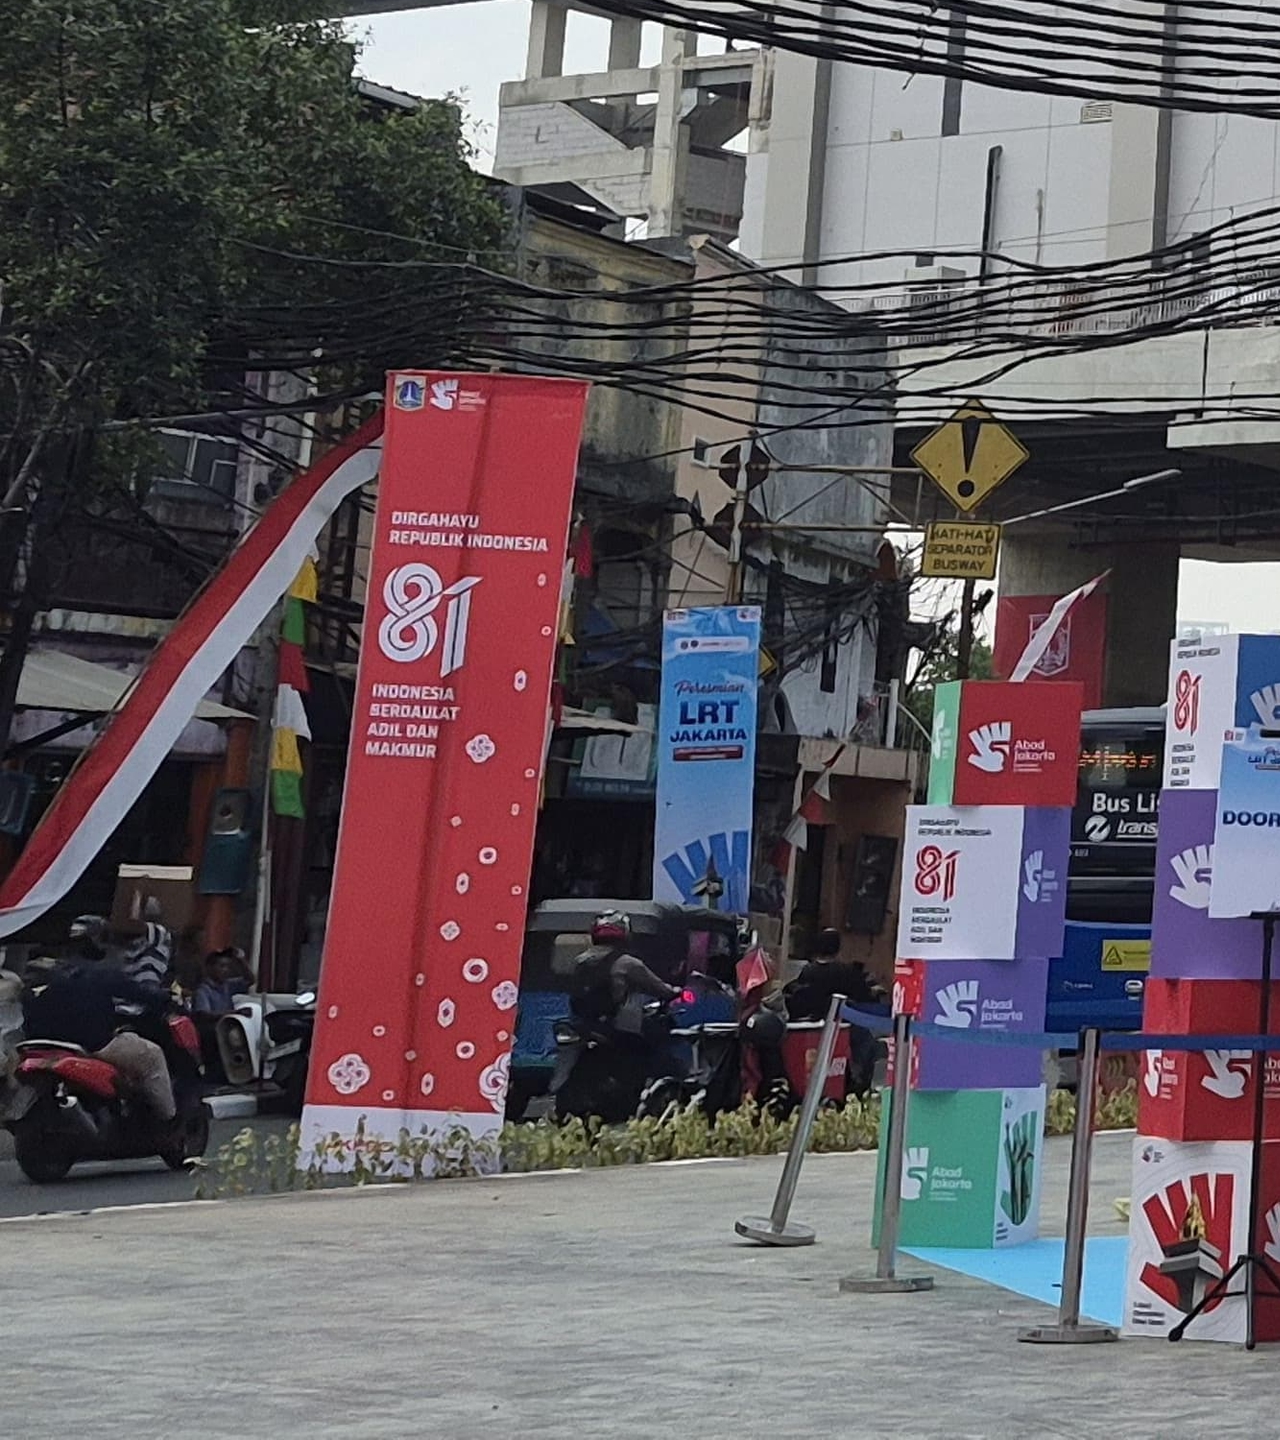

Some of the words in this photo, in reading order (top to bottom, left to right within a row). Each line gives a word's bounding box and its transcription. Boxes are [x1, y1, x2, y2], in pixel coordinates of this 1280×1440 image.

[391, 511, 480, 528] DIRGAHAYU
[389, 530, 464, 547] REPUBLIK
[467, 535, 549, 552] INDONESIA
[927, 544, 993, 556] SEPARATOR
[933, 559, 986, 571] BUSWAY
[378, 562, 484, 678] 81
[372, 683, 455, 701] INDONESIA
[1174, 669, 1202, 737] 81
[369, 704, 461, 721] BERDAULAT
[679, 699, 740, 725] LRT
[367, 722, 402, 737] ADIL
[406, 724, 438, 738] DAN
[669, 728, 748, 742] JAKARTA
[365, 741, 437, 758] MAKMUR
[1014, 739, 1045, 750] Abad
[1014, 750, 1055, 761] Jakarta
[1092, 793, 1130, 813] Bus
[1136, 793, 1159, 813] Li
[914, 845, 961, 902] 81
[981, 999, 1013, 1009] Abad
[931, 1166, 962, 1177] Abad
[931, 1178, 972, 1190] Jakarta
